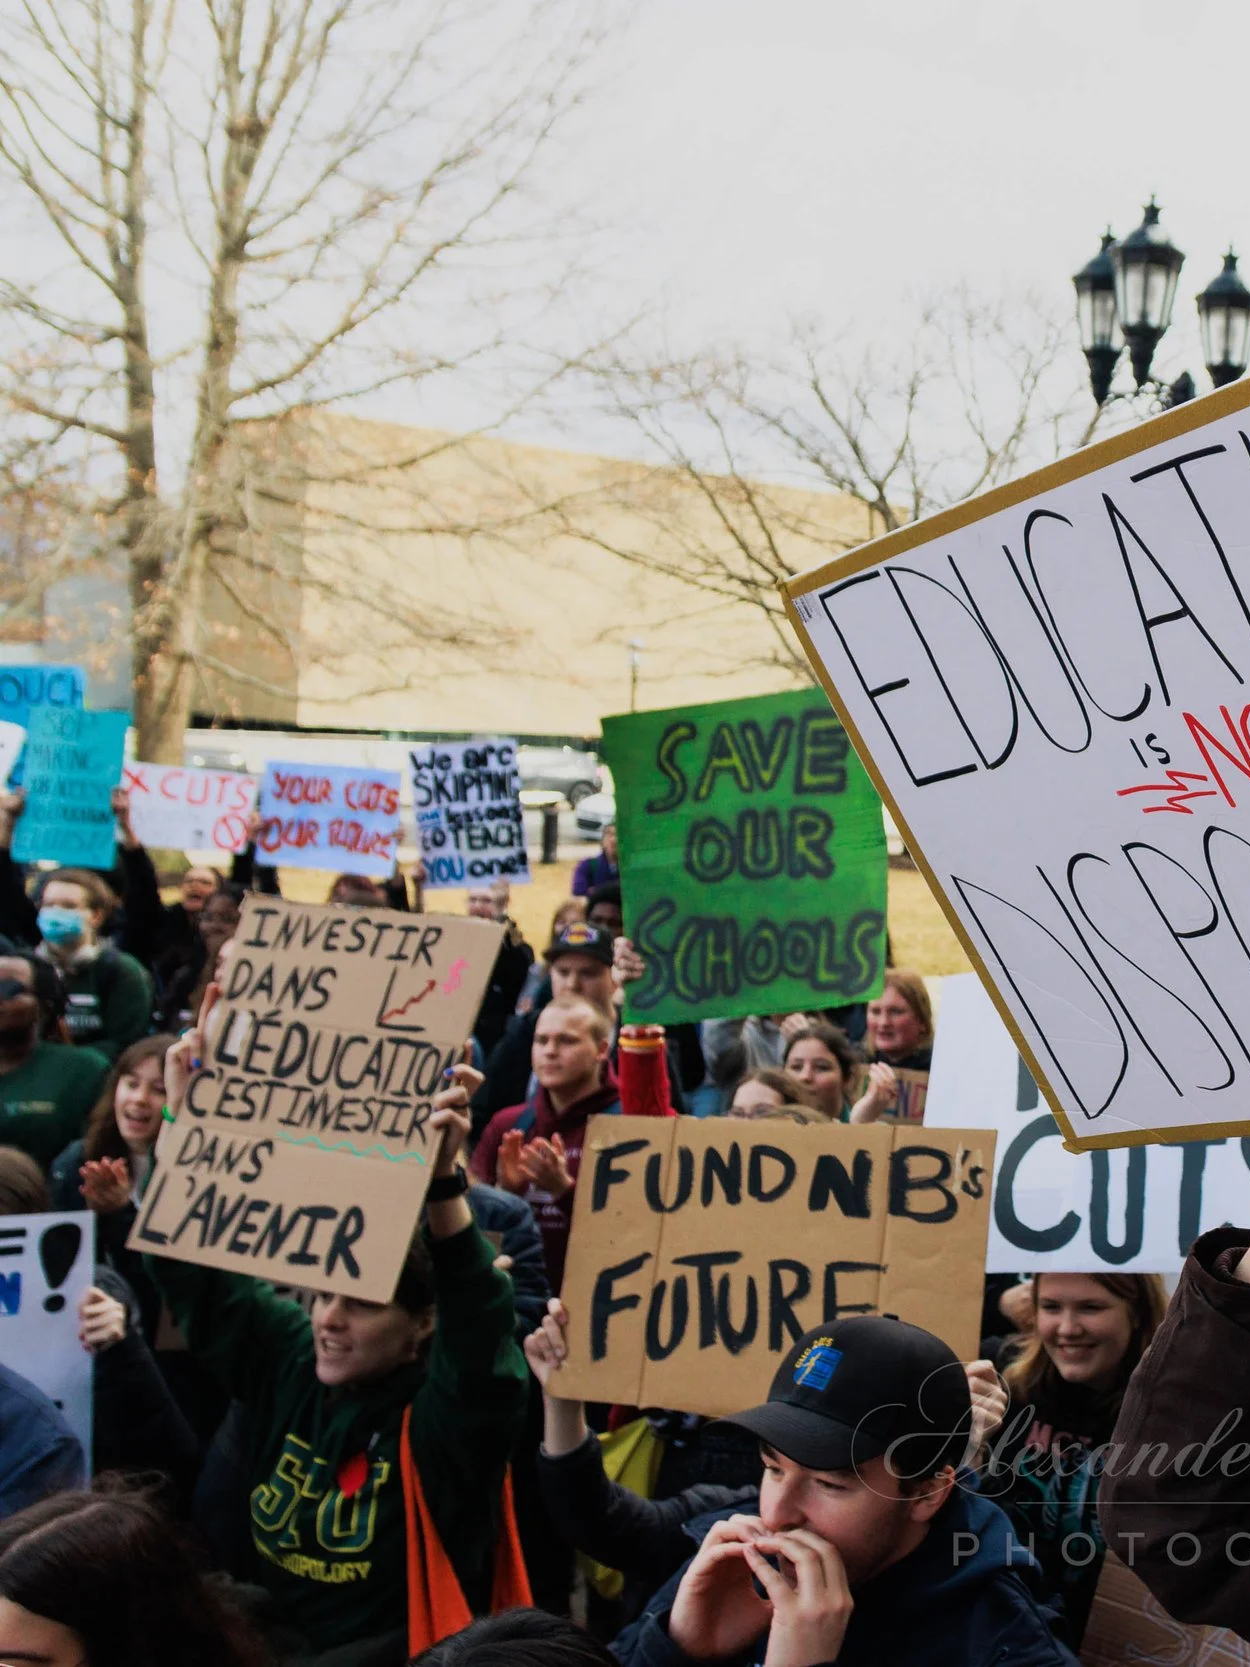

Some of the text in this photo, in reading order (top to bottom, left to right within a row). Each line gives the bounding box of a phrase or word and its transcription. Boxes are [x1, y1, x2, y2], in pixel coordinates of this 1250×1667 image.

[645, 707, 850, 813] SAVE
[1130, 732, 1171, 768] IS
[159, 770, 254, 811] CUTS
[272, 770, 399, 816] YOUR CUTS
[258, 815, 319, 852] OUR
[684, 806, 836, 884] OUR
[422, 857, 464, 883] YOU
[242, 907, 444, 968] INVESTIR
[631, 895, 884, 1010] SCHOOLS
[225, 958, 339, 1012] DANS
[175, 1127, 275, 1184] DANS
[591, 1139, 797, 1214] FUND
[138, 1172, 366, 1280] L'AVENIR
